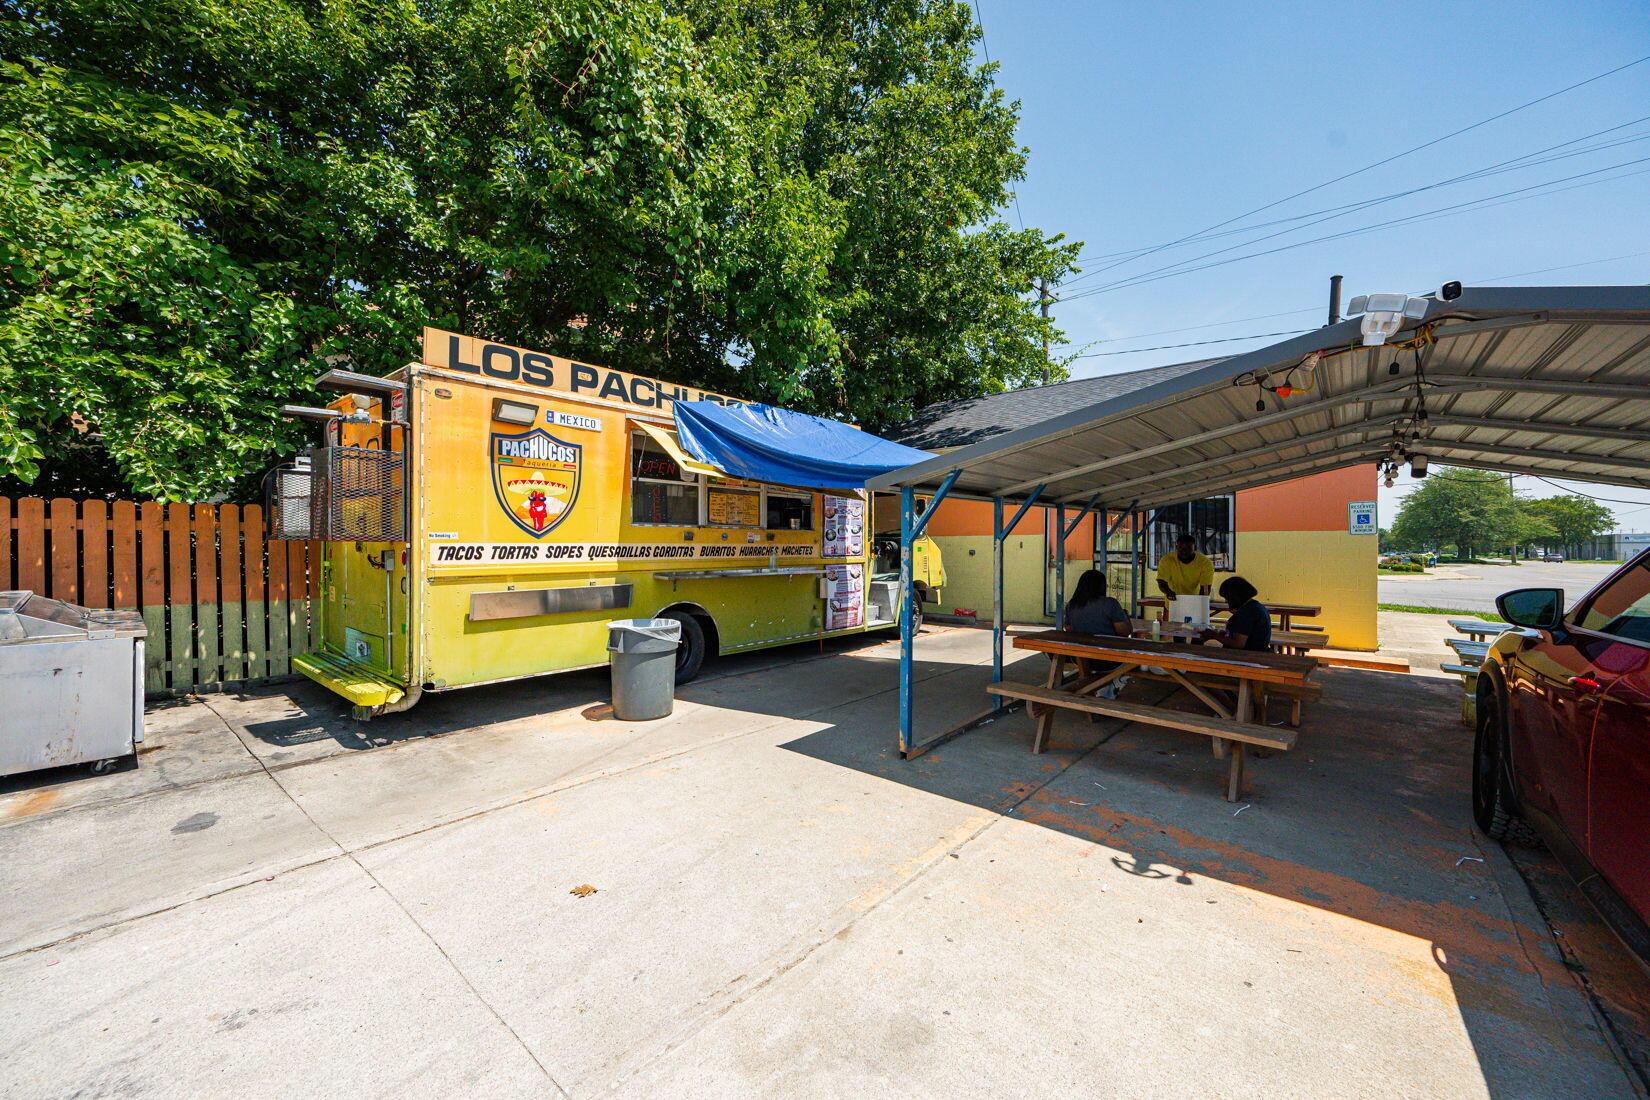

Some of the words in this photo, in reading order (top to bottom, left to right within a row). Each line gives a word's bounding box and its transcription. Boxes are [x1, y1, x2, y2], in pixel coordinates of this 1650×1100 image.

[448, 335, 554, 387] LOS
[559, 414, 596, 429] MEXICO
[501, 435, 576, 463] PACHUCOS
[641, 460, 676, 476] OPEN
[437, 545, 484, 561] TACOS
[490, 545, 540, 560] TORTAS
[545, 545, 584, 559] SOPES
[587, 545, 652, 561] QUESADILLAS
[653, 545, 695, 558] GORDITAS
[699, 545, 737, 557] BURRITOS
[781, 545, 814, 556] MACHETES
